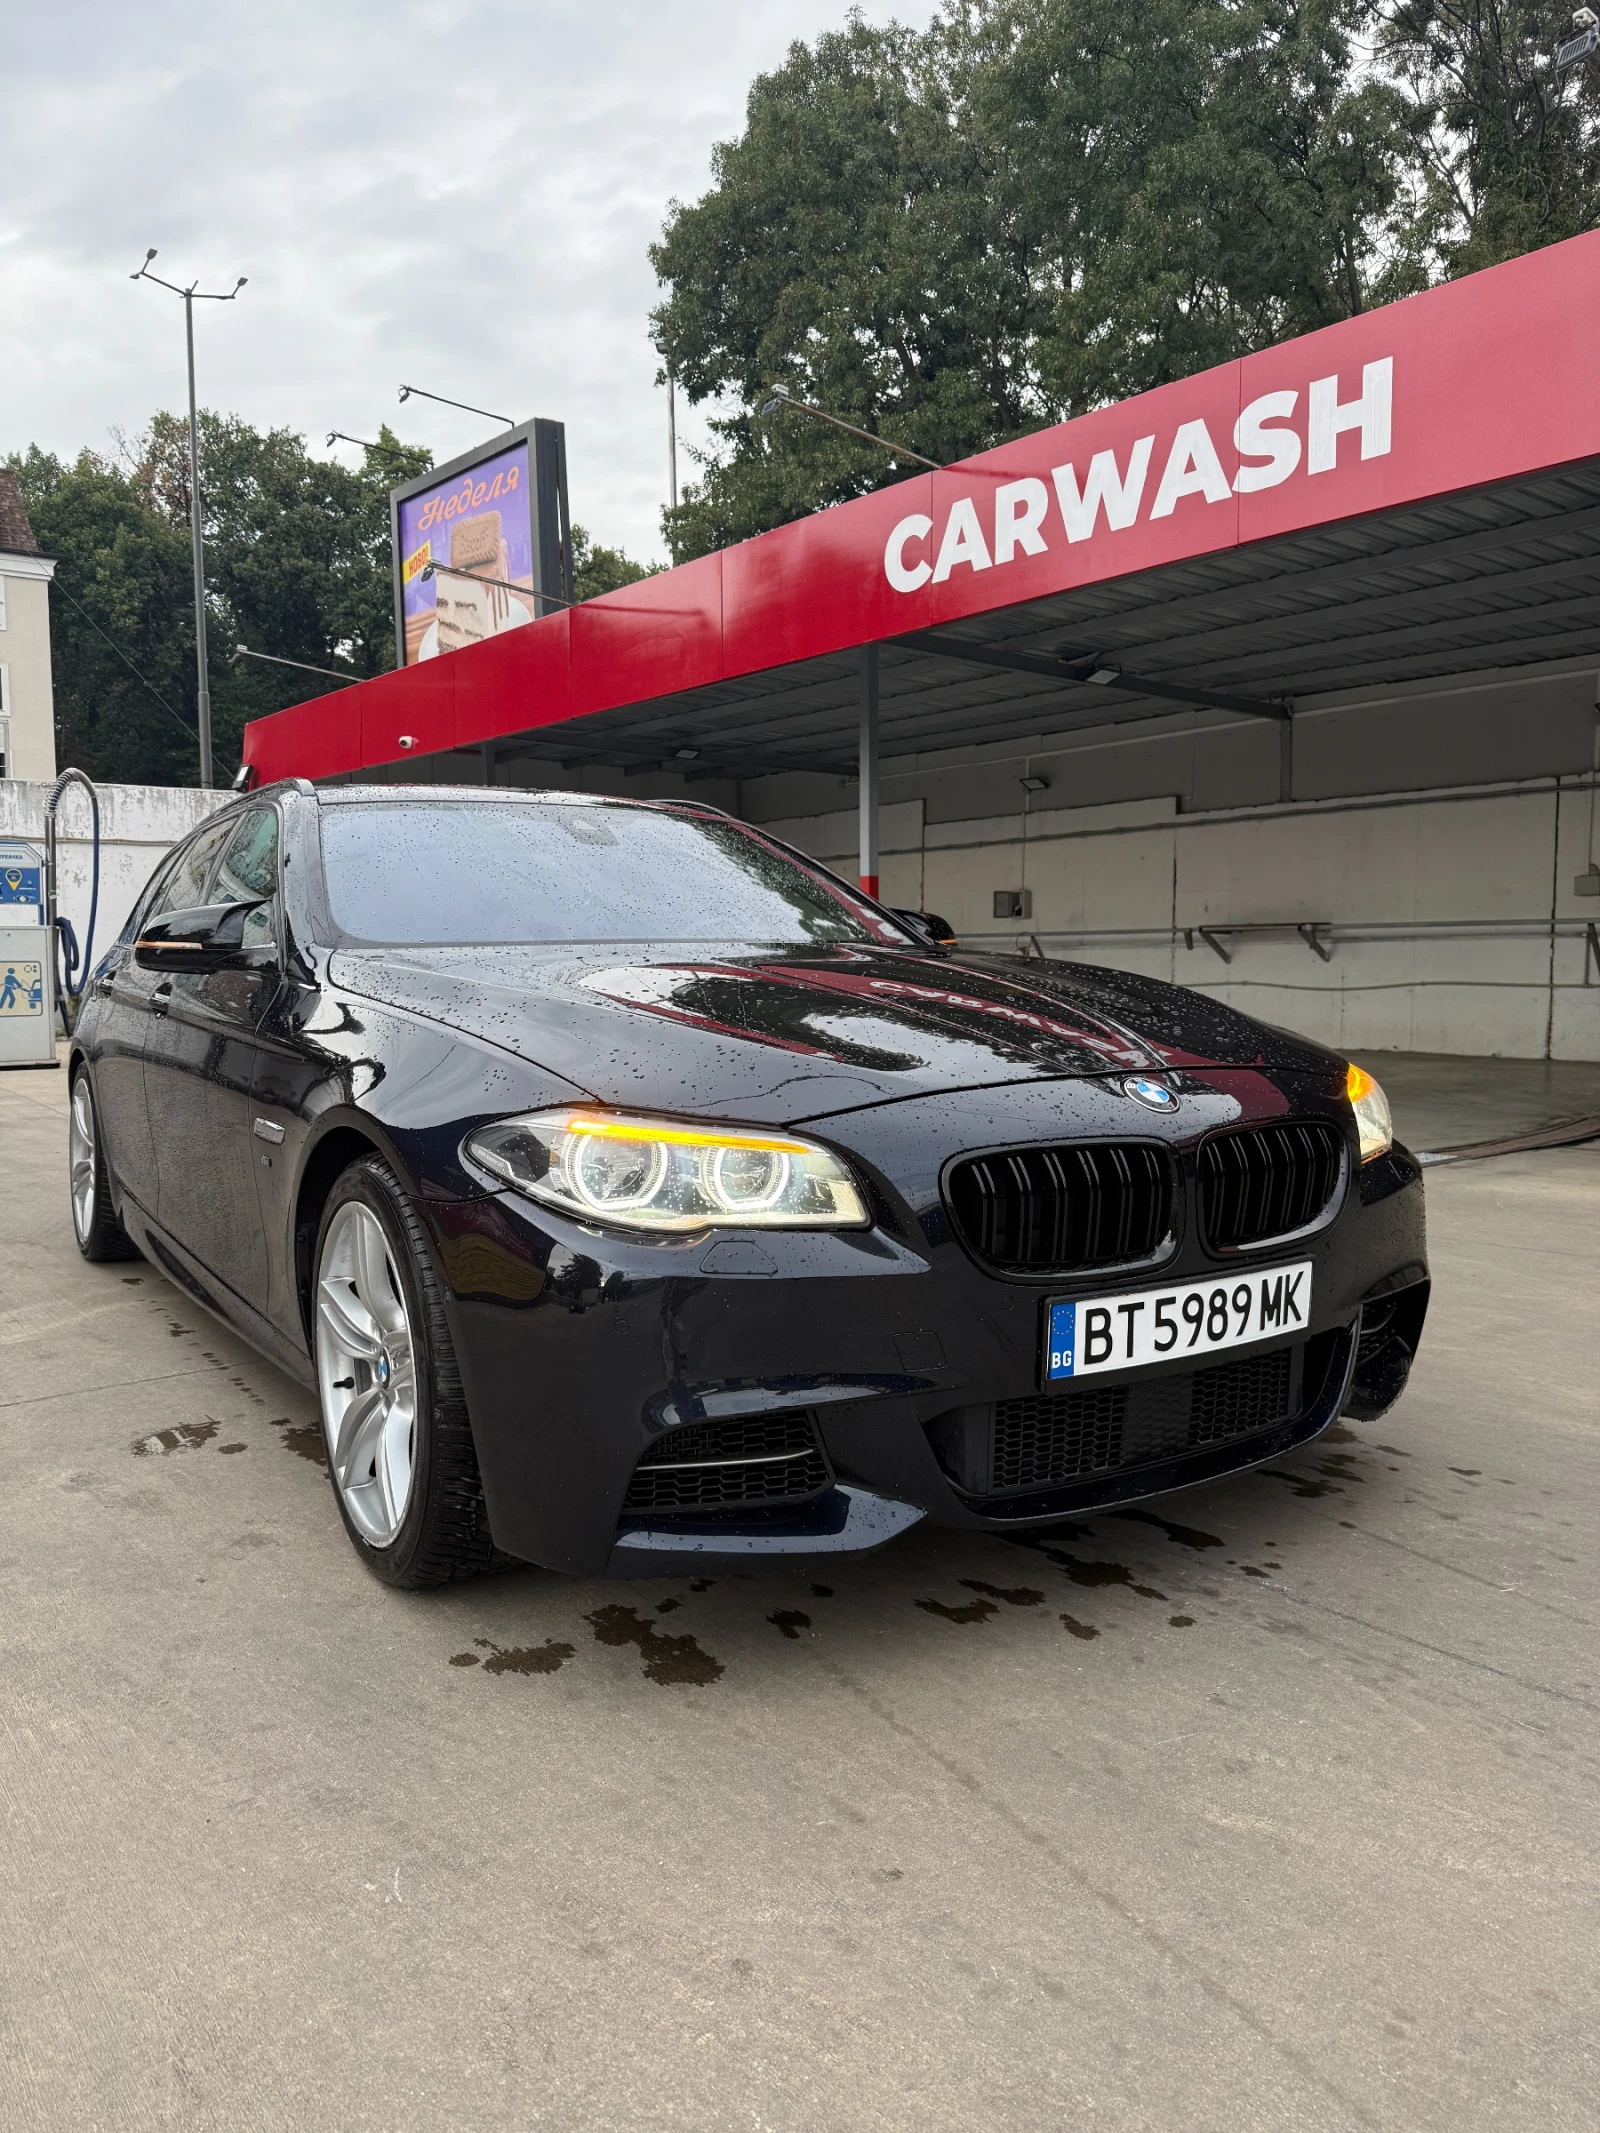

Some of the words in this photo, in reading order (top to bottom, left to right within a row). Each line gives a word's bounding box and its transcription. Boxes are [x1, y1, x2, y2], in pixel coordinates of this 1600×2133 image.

[418, 466, 519, 531] Неделя
[884, 356, 1394, 593] CARWASH
[1051, 1350, 1072, 1369] BG
